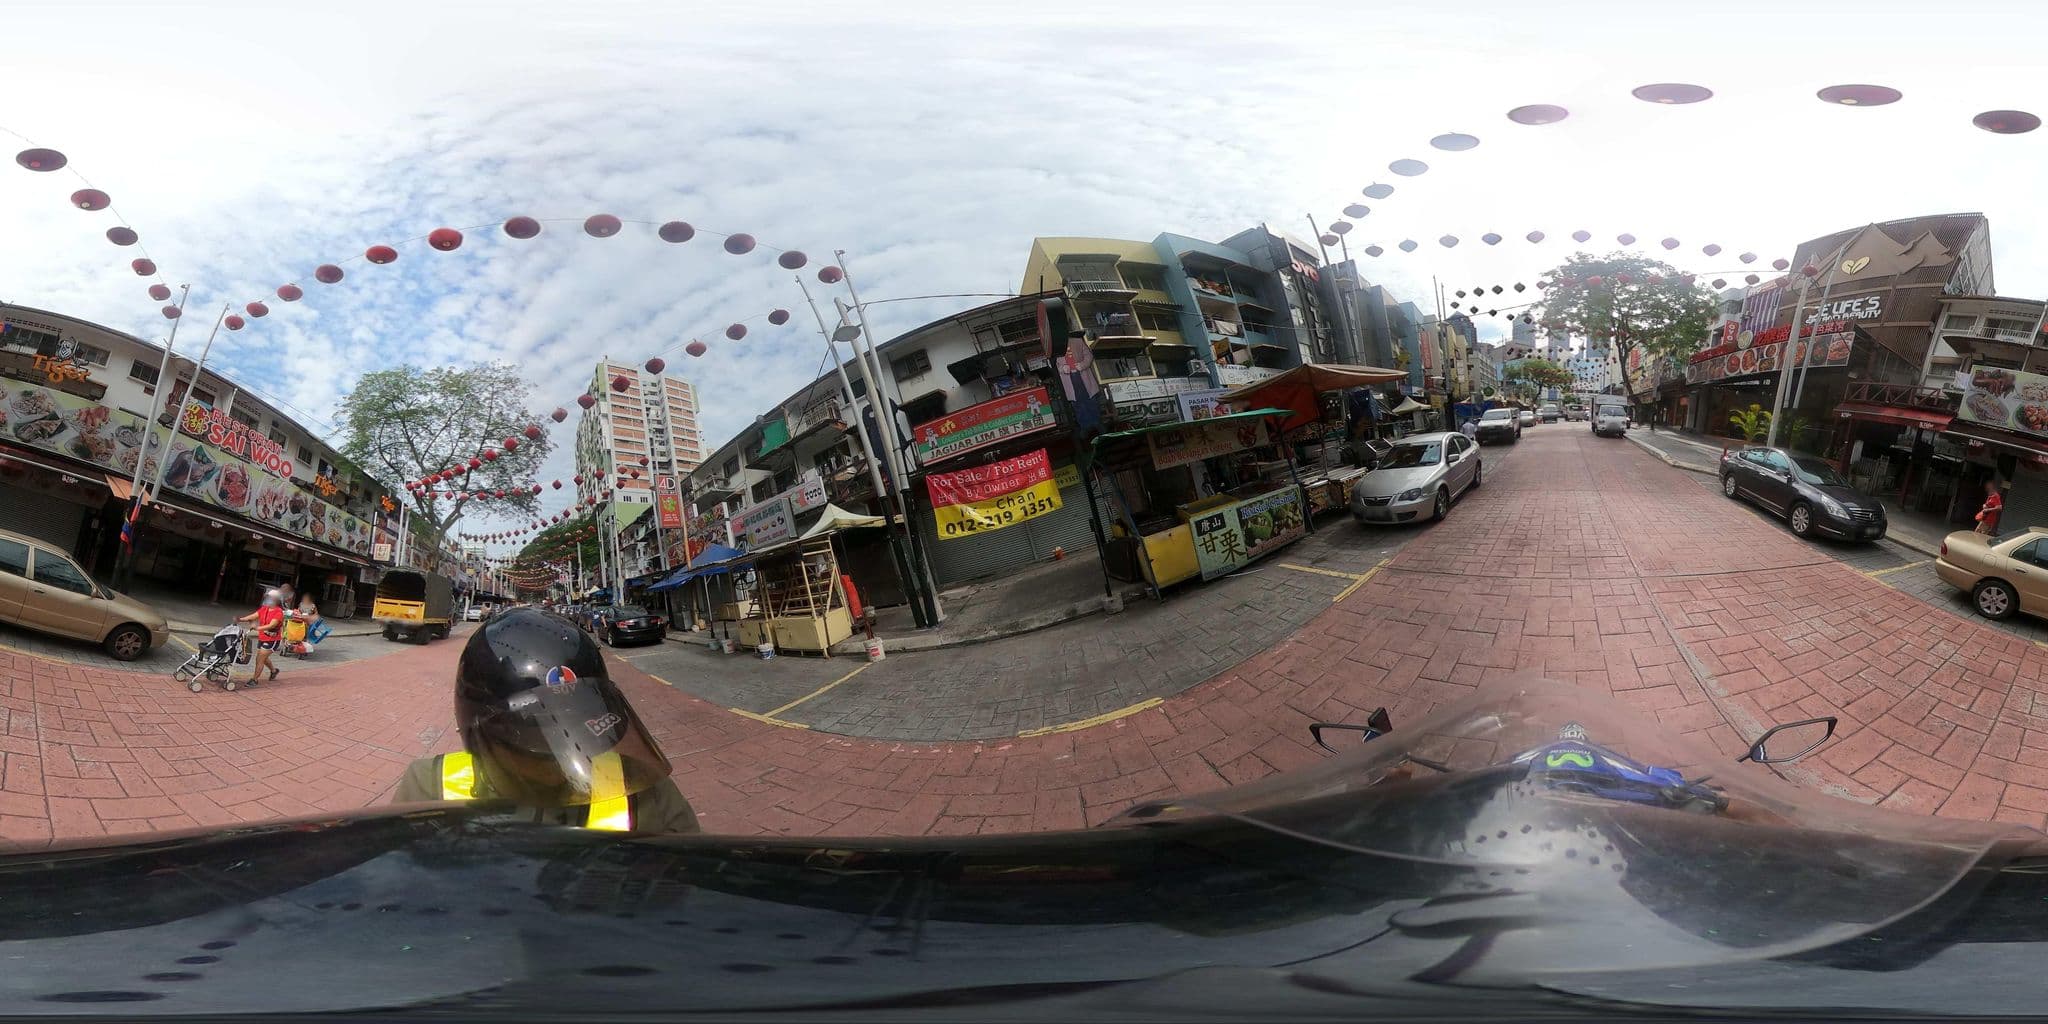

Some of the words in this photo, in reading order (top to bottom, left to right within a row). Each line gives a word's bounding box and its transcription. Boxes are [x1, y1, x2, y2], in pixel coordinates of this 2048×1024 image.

[32, 353, 92, 384] Tiger
[211, 407, 283, 455] RESTORAN
[930, 437, 974, 459] JAGUAR
[975, 430, 996, 445] LIM
[207, 422, 247, 457] SAI
[250, 440, 294, 479] WOO
[658, 477, 676, 490] 4D
[932, 476, 953, 488] For
[956, 470, 983, 485] Sale
[994, 465, 1015, 476] For
[1017, 453, 1044, 469] Rent
[804, 487, 822, 501] TOTO
[966, 485, 980, 498] By
[983, 476, 1020, 493] Owner
[996, 490, 1036, 510] Chan
[945, 509, 1014, 535] 012-219
[1020, 496, 1054, 517] 1351
[1198, 528, 1248, 564] 甘栗
